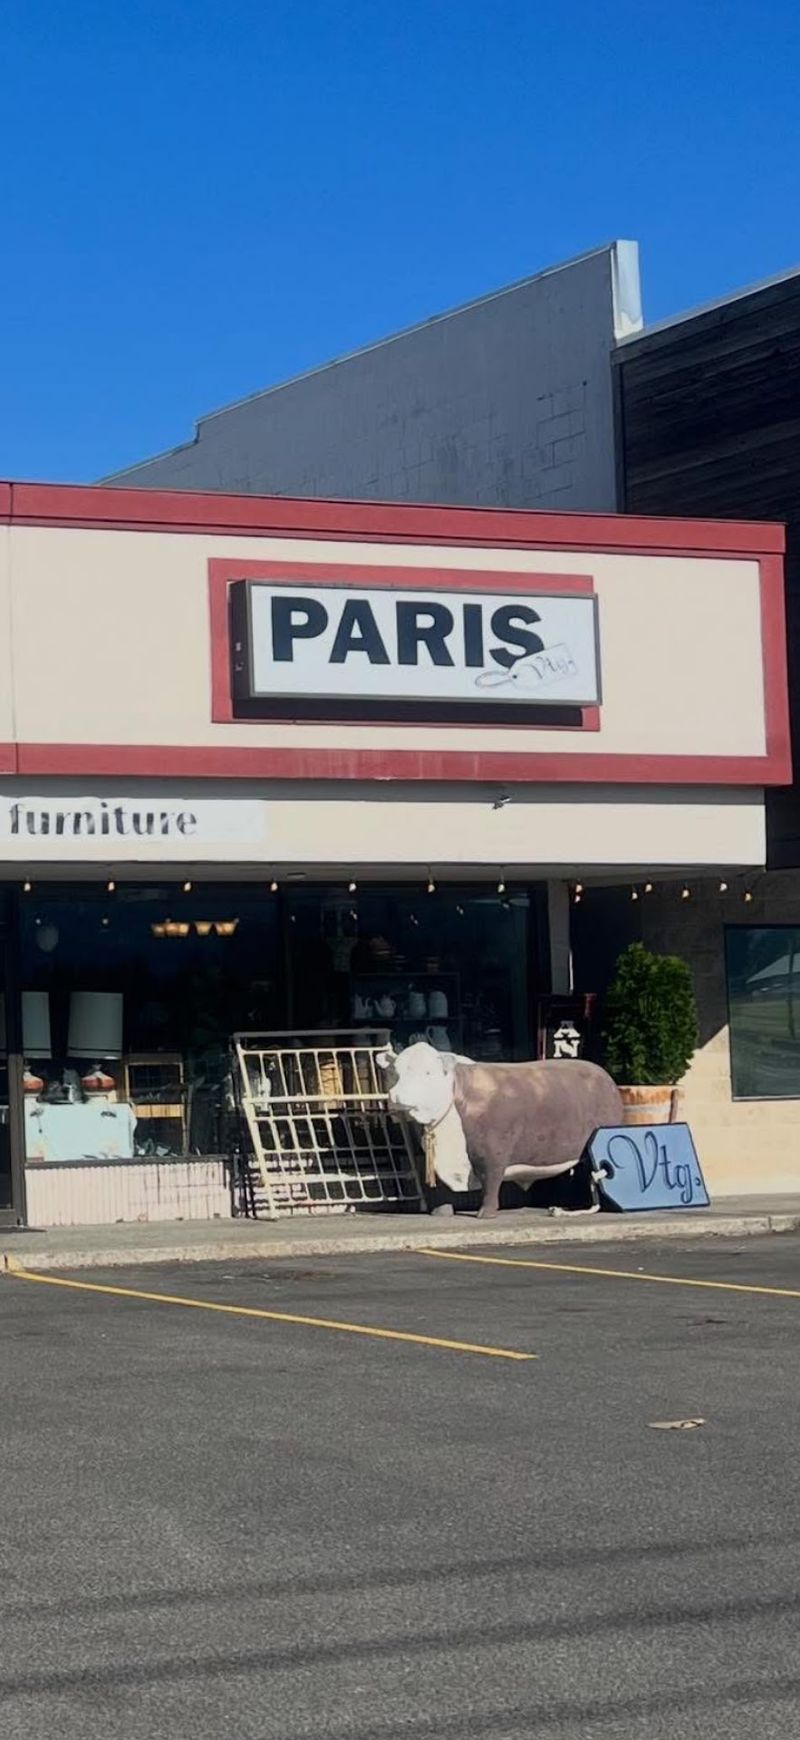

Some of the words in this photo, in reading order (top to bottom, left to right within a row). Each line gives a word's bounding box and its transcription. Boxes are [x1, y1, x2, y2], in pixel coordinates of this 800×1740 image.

[271, 596, 545, 669] PARIS
[9, 802, 197, 835] furniture
[607, 1131, 702, 1204] Vtg.
